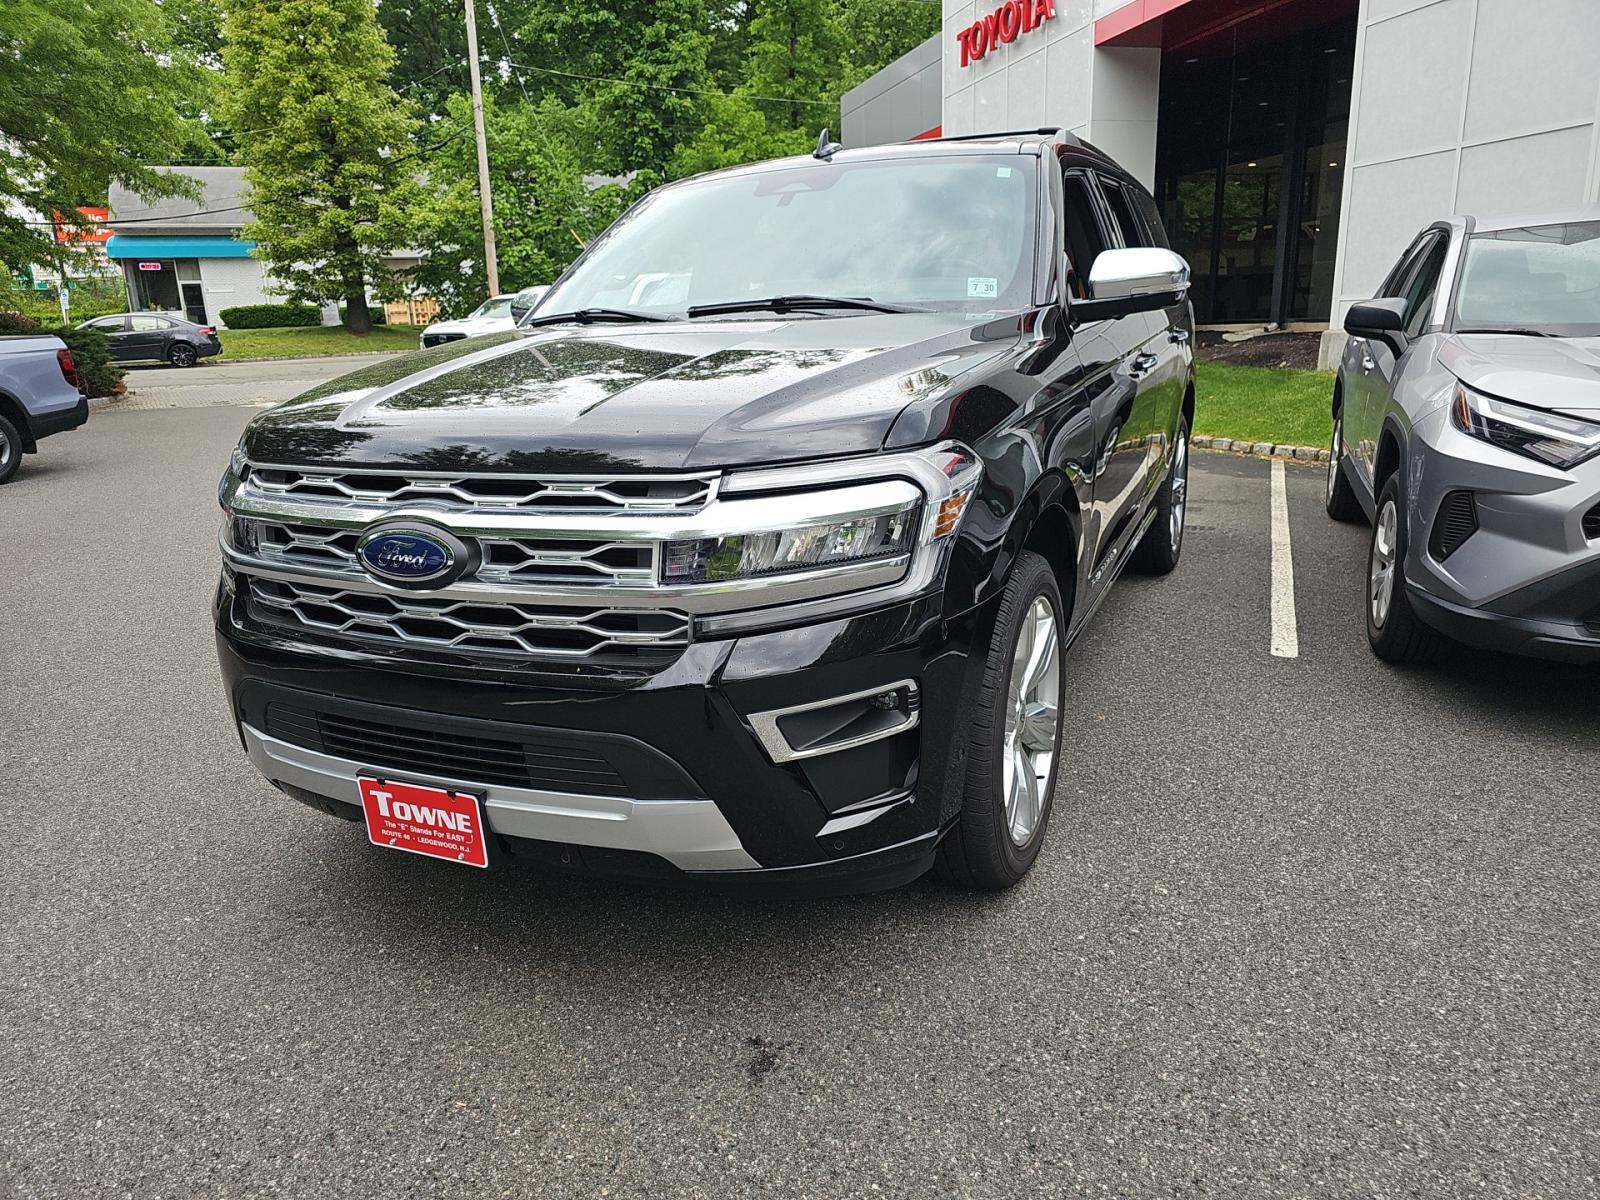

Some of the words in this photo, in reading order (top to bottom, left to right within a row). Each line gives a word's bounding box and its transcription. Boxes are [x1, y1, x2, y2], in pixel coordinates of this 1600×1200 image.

[957, 0, 1056, 67] TOYOTA
[378, 539, 428, 569] Ford
[369, 790, 473, 833] TOWNE
[381, 829, 402, 838] ROUTE
[384, 820, 397, 828] The
[410, 824, 433, 836] Stands
[433, 830, 444, 838] For
[446, 832, 465, 842] EASY
